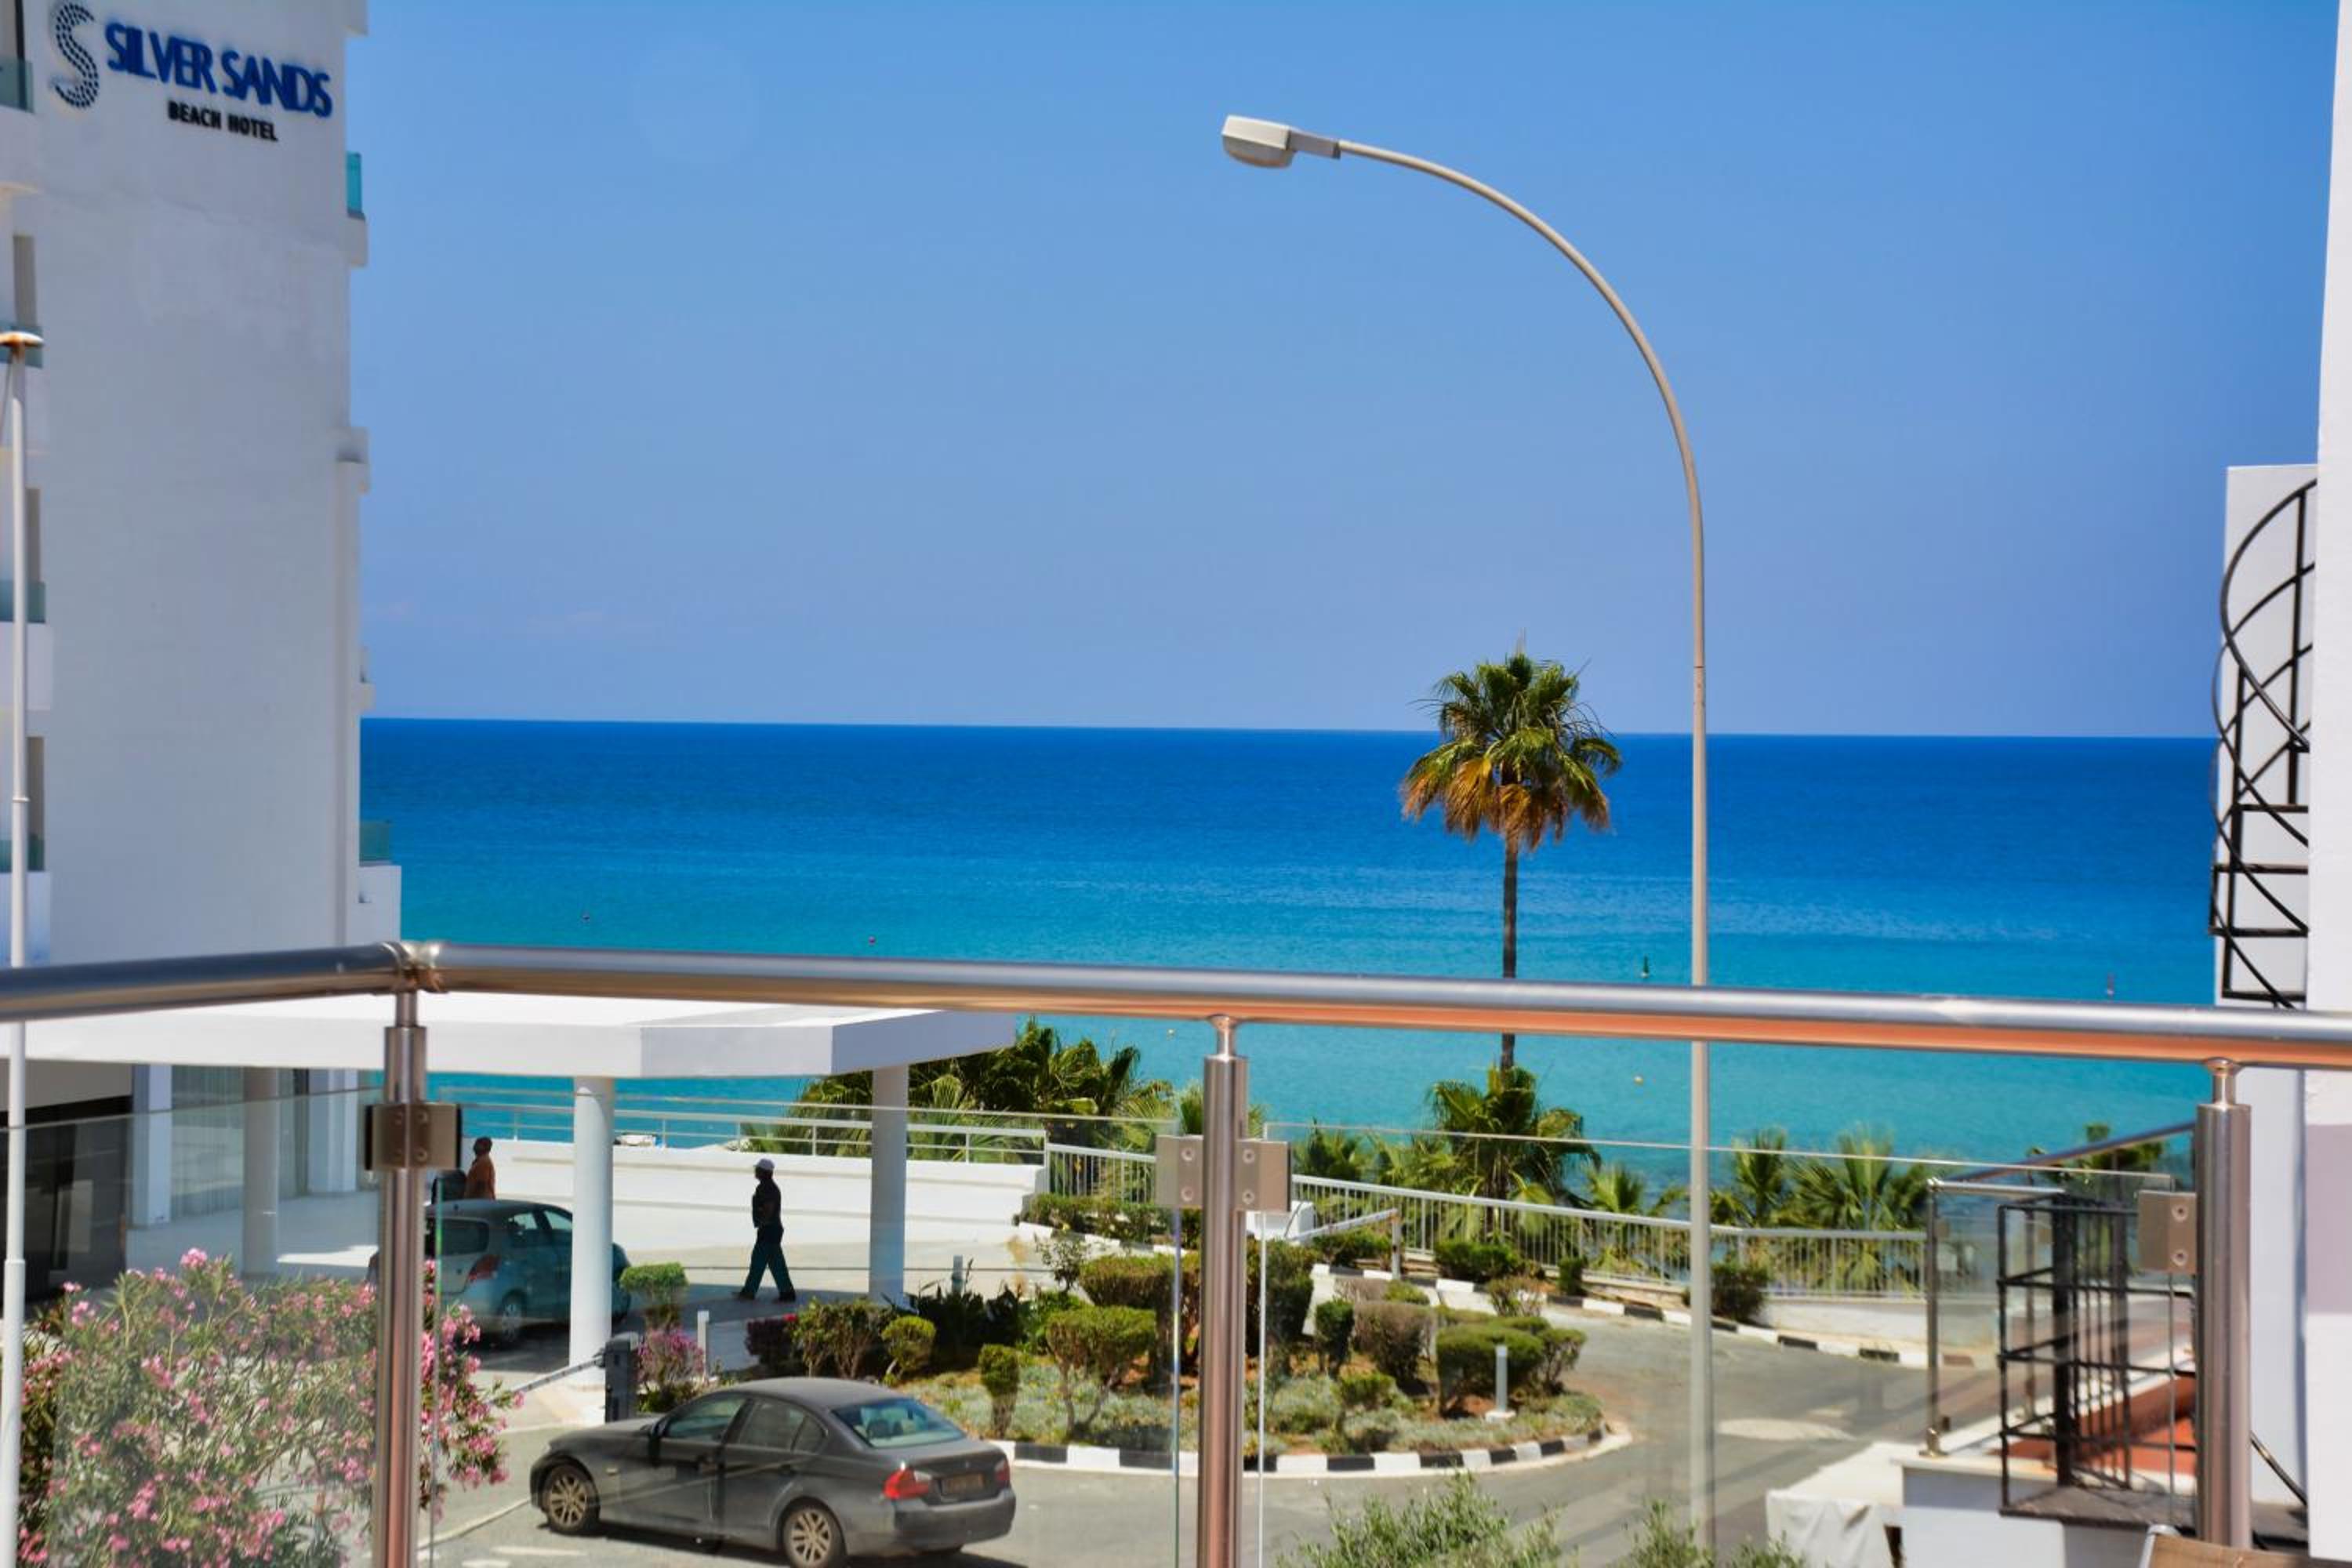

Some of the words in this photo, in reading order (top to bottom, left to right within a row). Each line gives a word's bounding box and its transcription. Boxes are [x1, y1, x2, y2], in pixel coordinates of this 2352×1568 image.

[105, 23, 217, 94] SILVER
[220, 49, 332, 118] SANDS
[168, 100, 221, 129] BEACH
[227, 114, 278, 142] HOTEL
